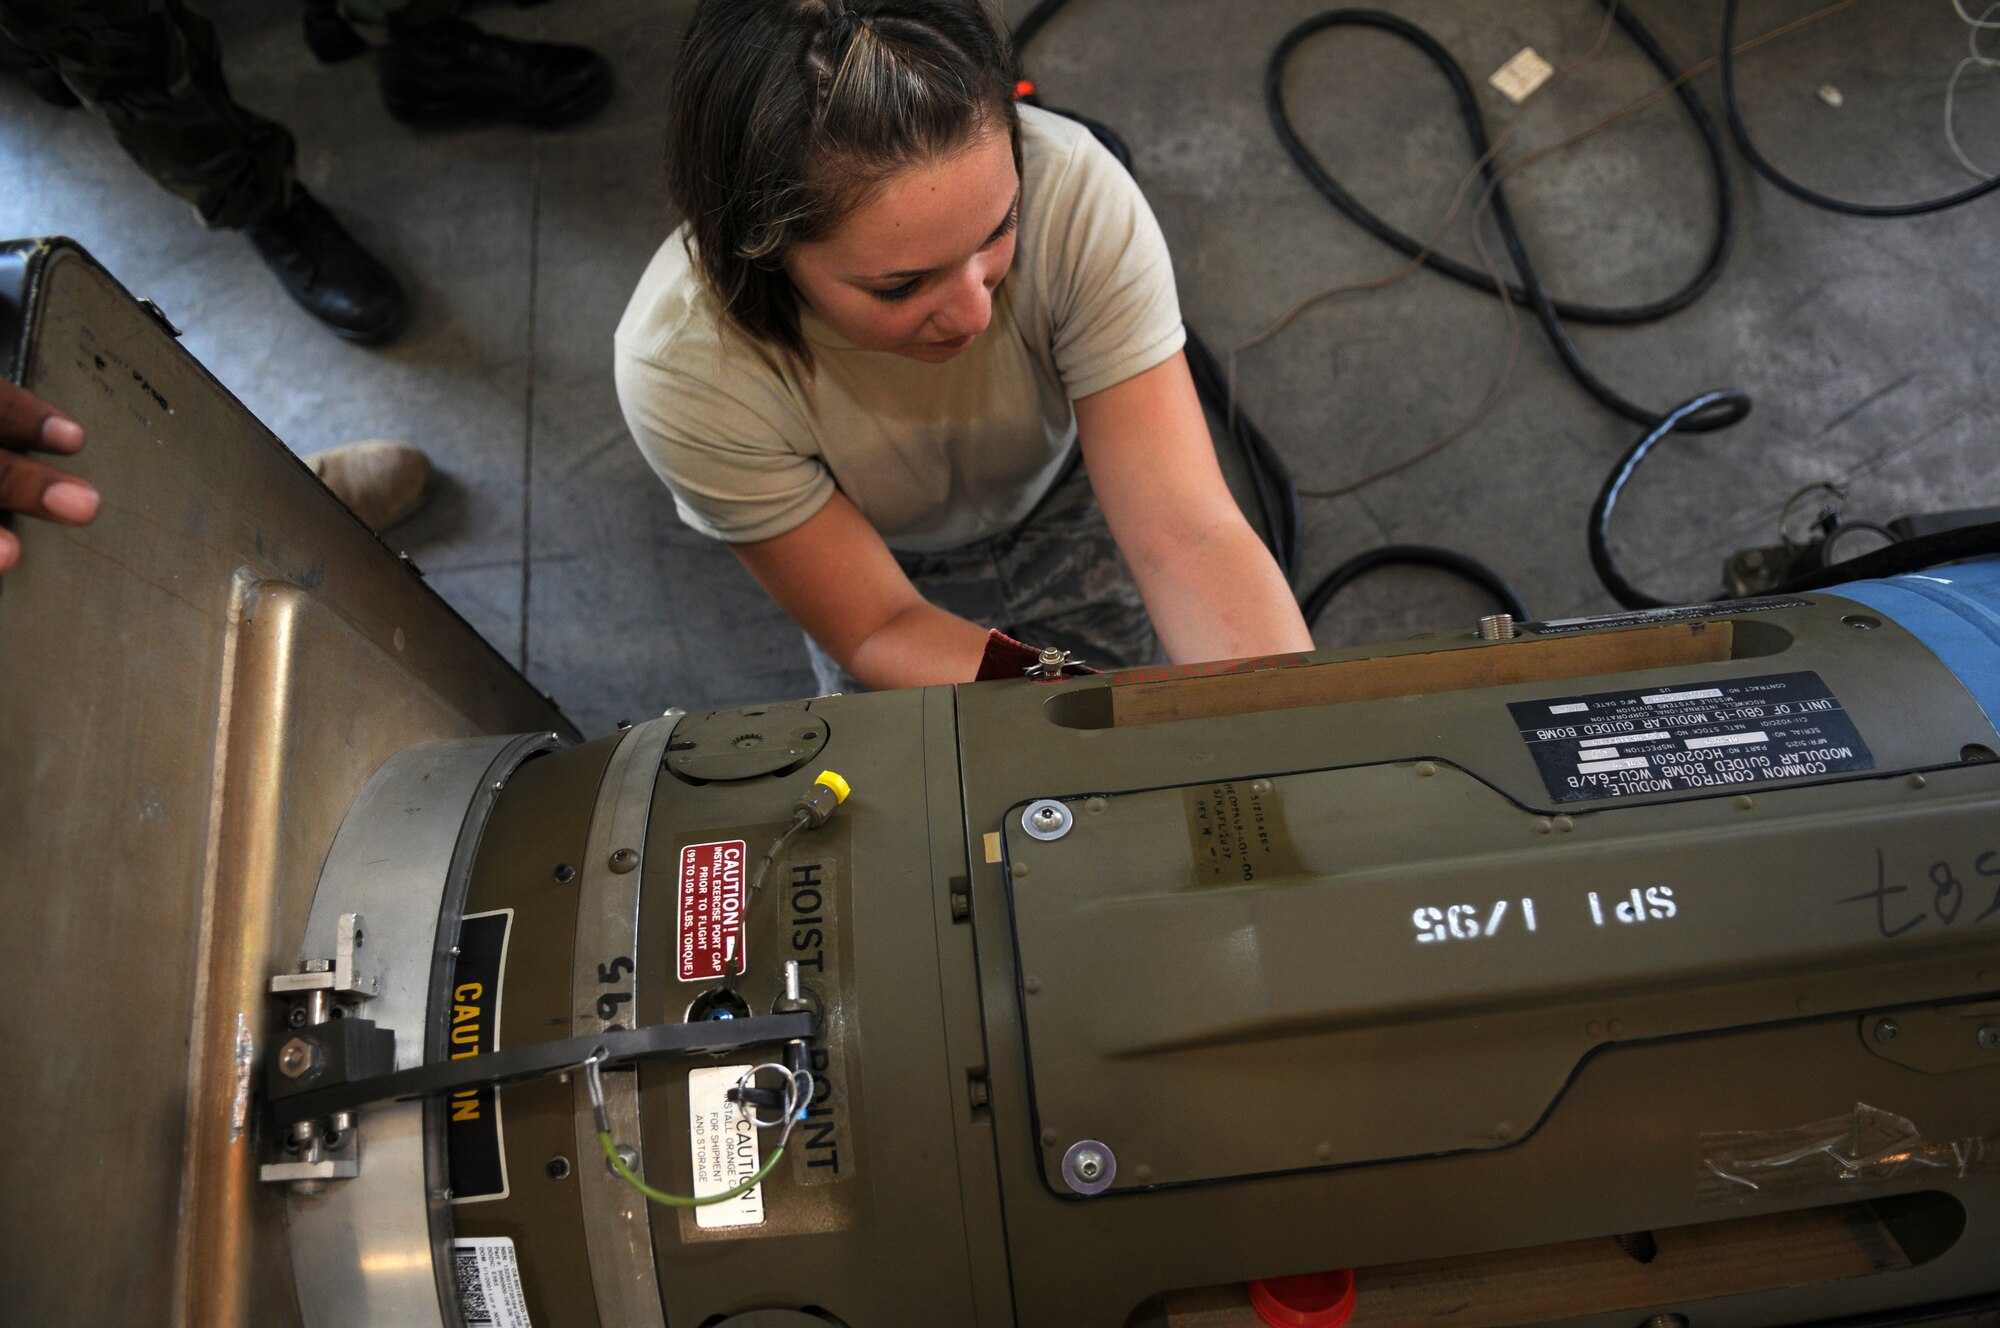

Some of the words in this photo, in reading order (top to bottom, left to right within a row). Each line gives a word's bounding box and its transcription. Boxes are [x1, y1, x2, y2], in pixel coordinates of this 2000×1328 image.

[1742, 682, 1786, 691] CONTRACT
[1654, 700, 1695, 709] SYSTEMS
[1698, 696, 1733, 704] MISSILE
[1721, 698, 1766, 708] ROCKWELL
[1795, 699, 1832, 711] UNIT
[1614, 704, 1652, 713] DIVISION
[1651, 703, 1719, 715] INTERNATIONAL
[1712, 706, 1765, 720] GBU-15
[1769, 703, 1791, 714] OF
[1589, 711, 1649, 722] CORPORATION
[1640, 712, 1708, 728] MODULAR
[1535, 726, 1577, 739] BOMB
[1583, 720, 1634, 734] GUIDED
[1691, 726, 1720, 734] STOCK
[1722, 723, 1746, 731] NATL
[1788, 727, 1821, 735] SERIAL
[1741, 744, 1767, 752] PART
[1778, 746, 1853, 764] MODULAR
[1659, 762, 1707, 776] BOMB
[1711, 755, 1771, 771] GUIDED
[1760, 761, 1828, 778] COMMON
[1565, 768, 1653, 787] WCU-6A/B
[1679, 768, 1755, 787] CONTROL
[686, 849, 695, 863] (95
[713, 847, 722, 877] INSTALL
[686, 865, 694, 876] TO
[685, 879, 694, 893] 105
[699, 867, 708, 894] PRIOR
[723, 849, 740, 932] CAUTION!
[685, 896, 693, 907] IN.
[699, 898, 707, 910] TO
[712, 880, 721, 921] EXERCISE
[685, 911, 693, 930] LBS.
[792, 864, 824, 973] HOIST
[698, 916, 707, 950] FLIGHT
[712, 925, 721, 948] PORT
[684, 932, 693, 975] TORQUE)
[712, 952, 720, 971] CAP
[450, 982, 483, 1122] CAUTN
[696, 1115, 705, 1135] AND
[710, 1112, 719, 1131] FOR
[697, 1139, 707, 1182] STORAGE
[710, 1135, 722, 1182] SHIPMENT
[726, 1138, 735, 1176] ORANGE
